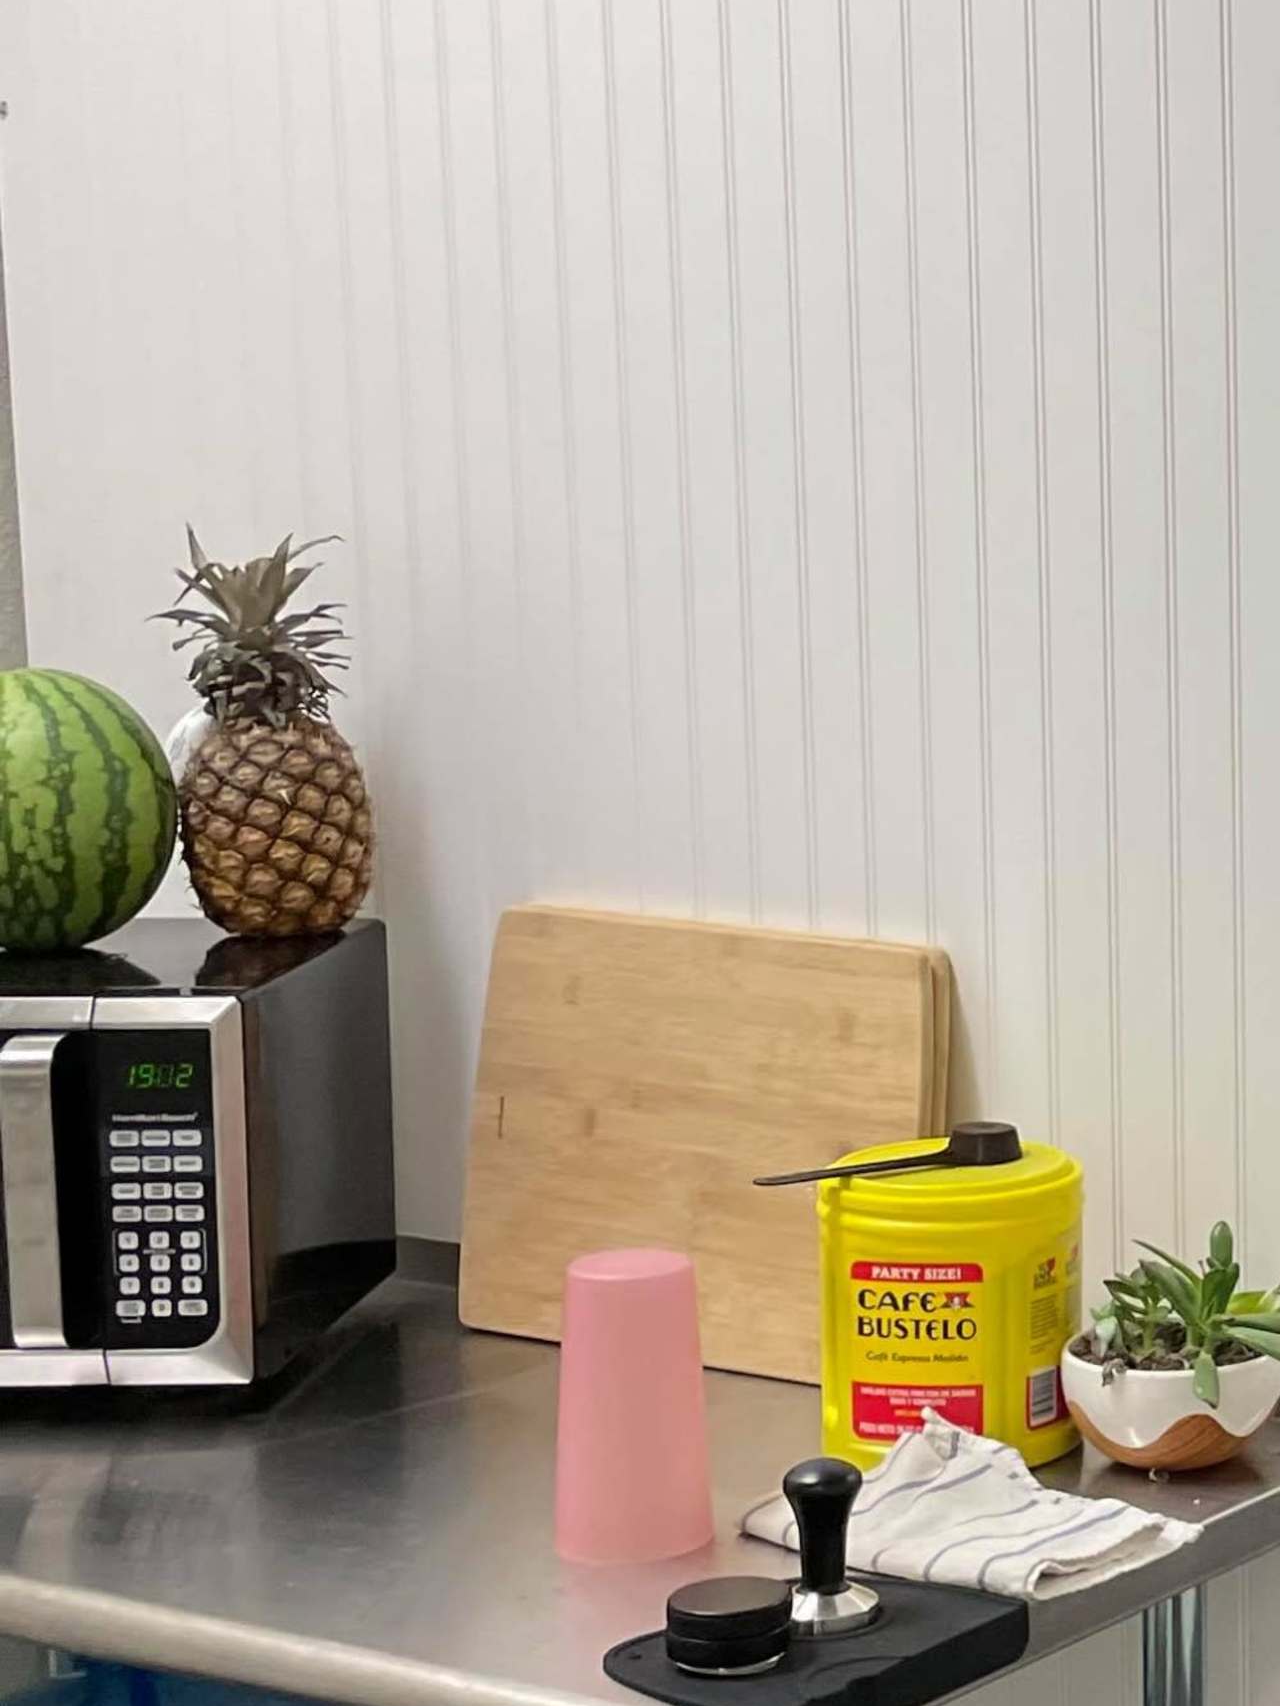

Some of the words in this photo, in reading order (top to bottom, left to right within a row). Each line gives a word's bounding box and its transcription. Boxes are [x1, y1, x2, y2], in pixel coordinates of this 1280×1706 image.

[871, 1266, 921, 1280] PARTY
[924, 1267, 962, 1281] SIZE!
[857, 1316, 977, 1341] BUSTELO
